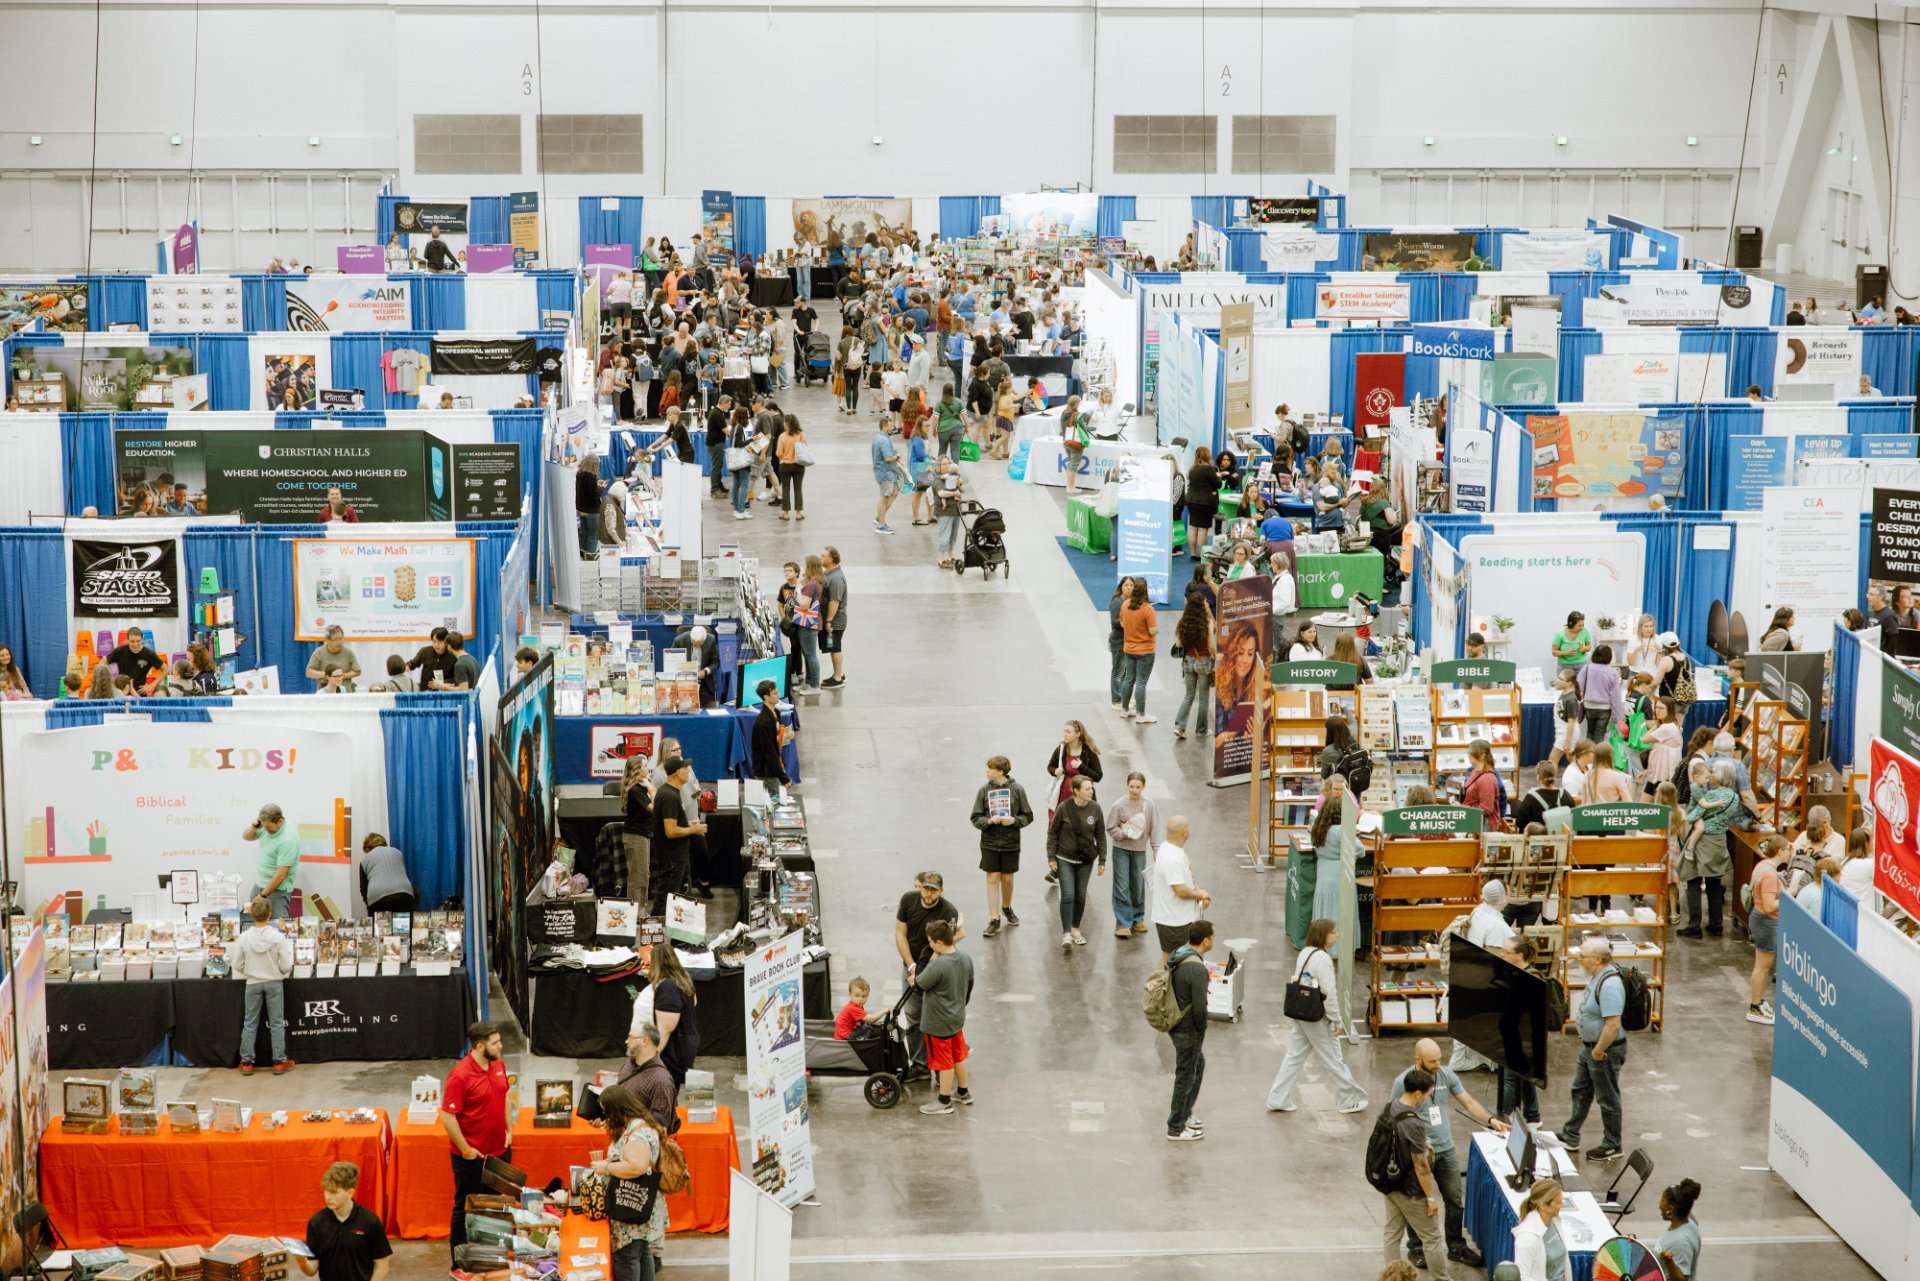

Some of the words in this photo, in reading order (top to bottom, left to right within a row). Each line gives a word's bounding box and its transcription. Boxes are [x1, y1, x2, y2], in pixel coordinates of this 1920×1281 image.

[521, 64, 533, 79] A
[1220, 65, 1232, 80] A
[1776, 63, 1788, 79] A
[522, 81, 532, 97] 3
[1221, 83, 1231, 98] 2
[1778, 81, 1785, 95] 1
[375, 287, 405, 301] AIM
[1414, 341, 1494, 360] BookShark
[125, 440, 162, 448] RESTORE
[164, 440, 197, 448] HIGHER
[125, 449, 177, 457] EDUCATION.
[273, 446, 331, 458] CHRISTIAN
[333, 446, 371, 458] HALLS
[222, 468, 258, 479] WHERE
[260, 468, 330, 479] HOMESCHOOL
[332, 468, 352, 478] AND
[354, 468, 391, 478] HIGHER
[393, 468, 408, 478] ED
[275, 481, 308, 491] COME
[310, 481, 358, 491] TOGETHER
[1877, 522, 1920, 534] DESERV
[1878, 535, 1894, 546] TO
[1896, 536, 1920, 547] KNO
[340, 544, 354, 556] We
[357, 545, 382, 556] Make
[384, 544, 408, 556] Math
[1881, 548, 1909, 559] HOW
[1479, 556, 1523, 569] Reading
[1526, 556, 1562, 567] starts
[1565, 555, 1592, 567] here
[96, 570, 161, 580] SPEED
[1296, 570, 1327, 584] hark
[80, 579, 171, 596] STACKS
[1290, 667, 1339, 678] HISTORY
[1456, 666, 1490, 677] BIBLE
[189, 747, 297, 774] KIDS!
[136, 796, 187, 808] Biblical
[1399, 809, 1467, 822] CHARACTER
[1581, 808, 1628, 818] CHARLOTTE
[1629, 807, 1660, 817] MASON
[1409, 821, 1417, 831] &
[1419, 819, 1456, 831] MUSIC
[1602, 816, 1639, 828] HELPS
[768, 962, 785, 977] BOOK
[1783, 932, 1837, 1007] biblingo
